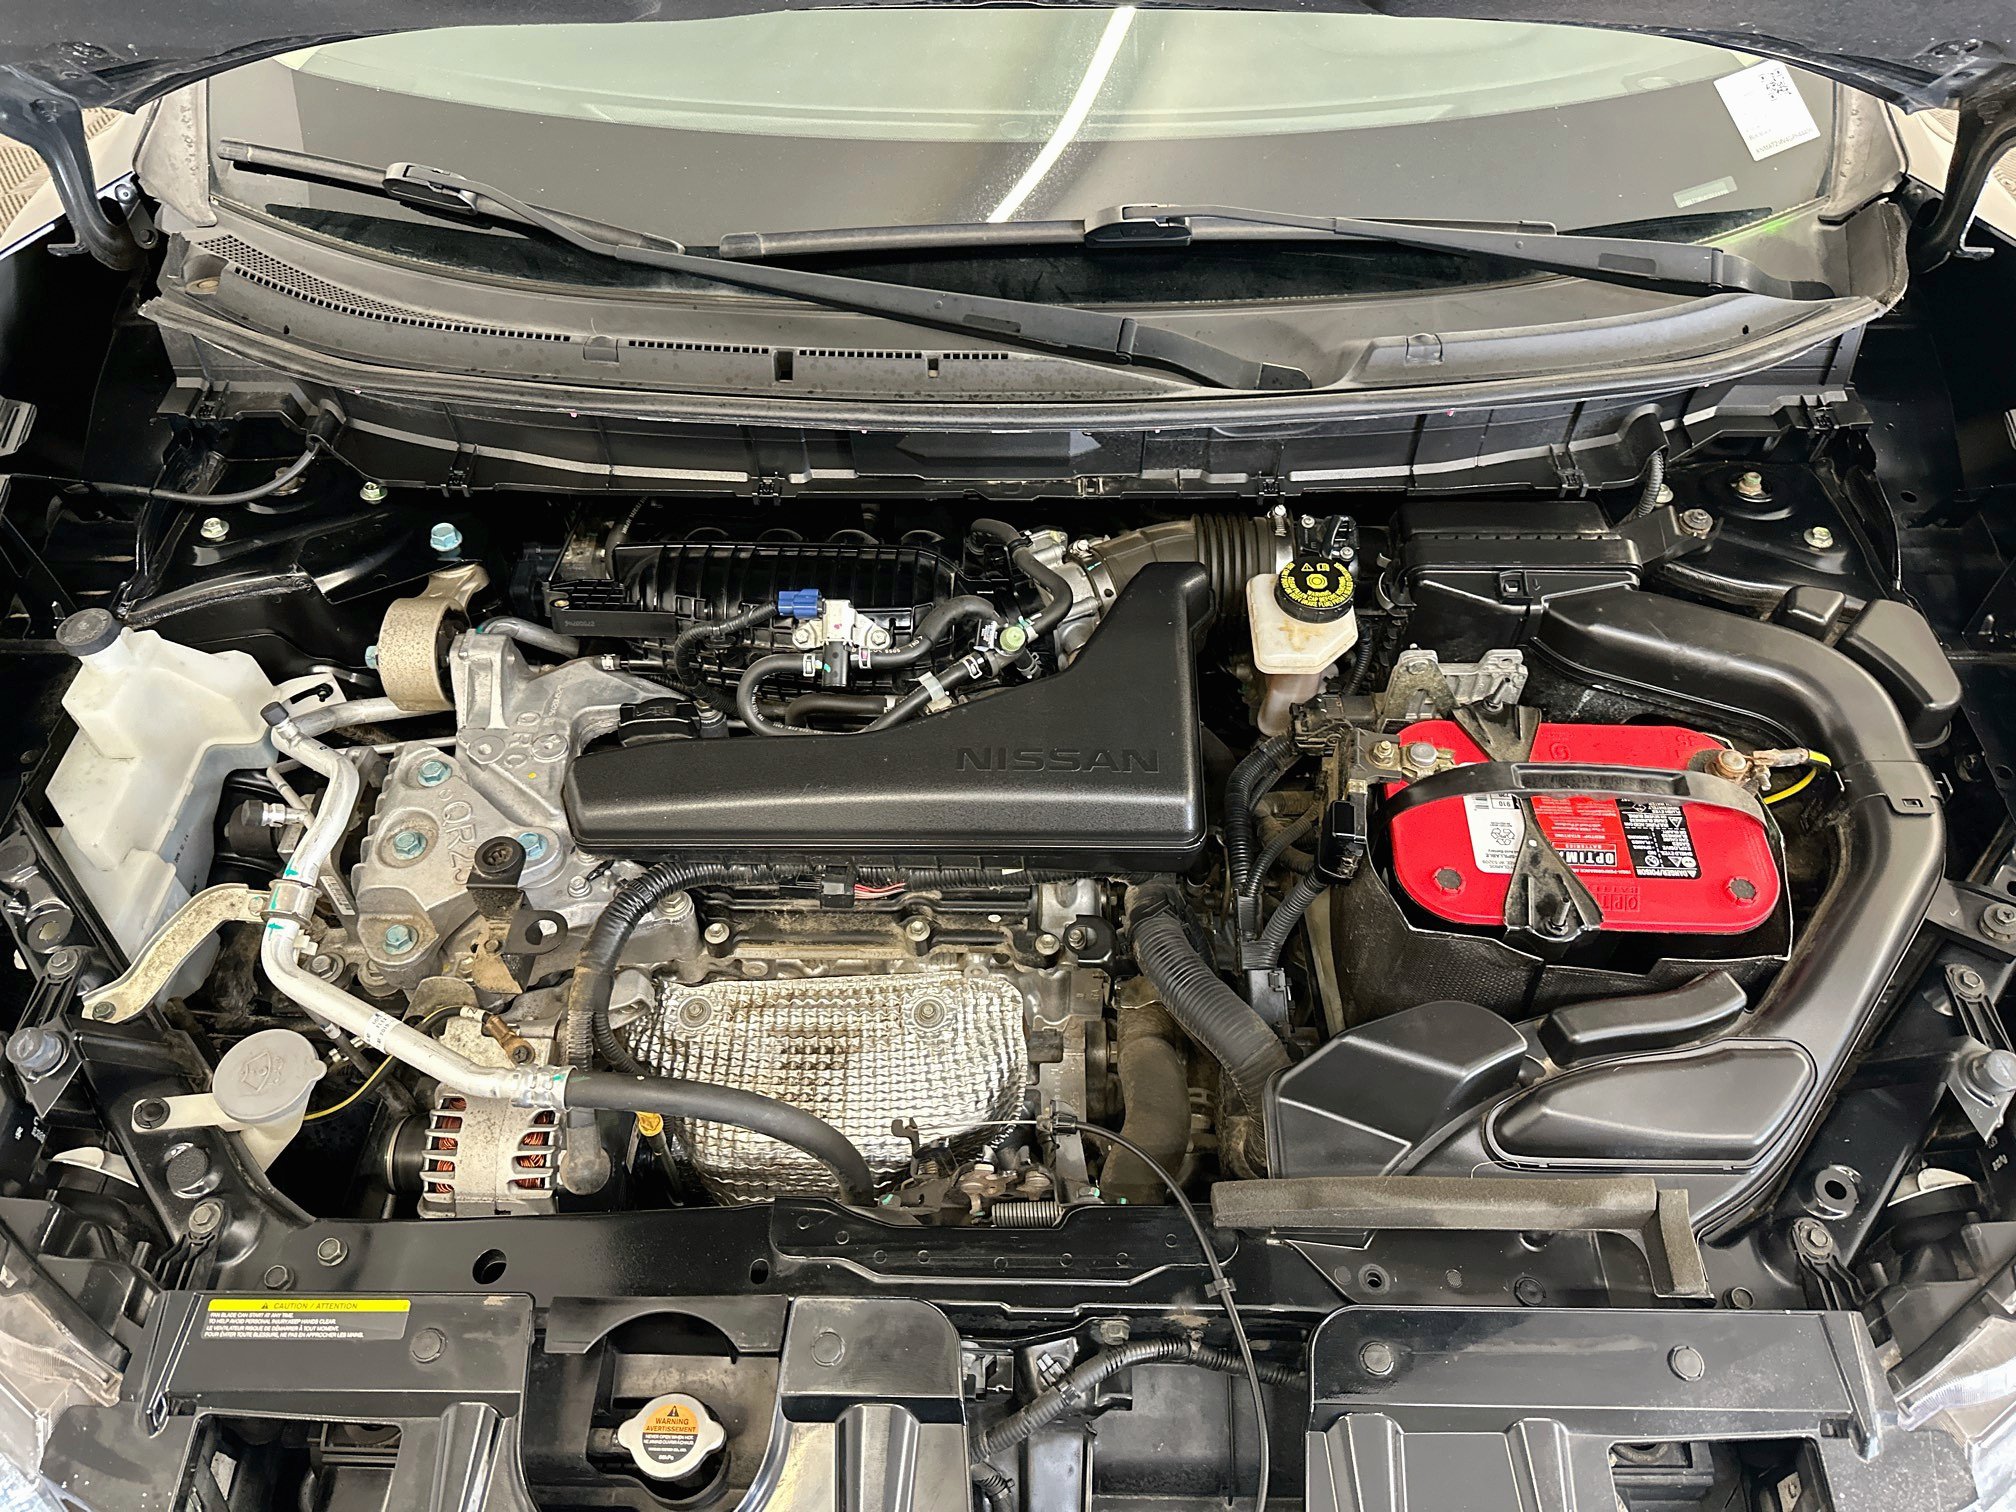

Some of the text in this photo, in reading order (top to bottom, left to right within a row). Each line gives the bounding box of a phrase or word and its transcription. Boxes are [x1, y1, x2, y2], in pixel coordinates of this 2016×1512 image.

[956, 748, 1160, 773] NISSAN
[1636, 869, 1689, 877] DANGER/POISON
[1602, 896, 1637, 910] OPT
